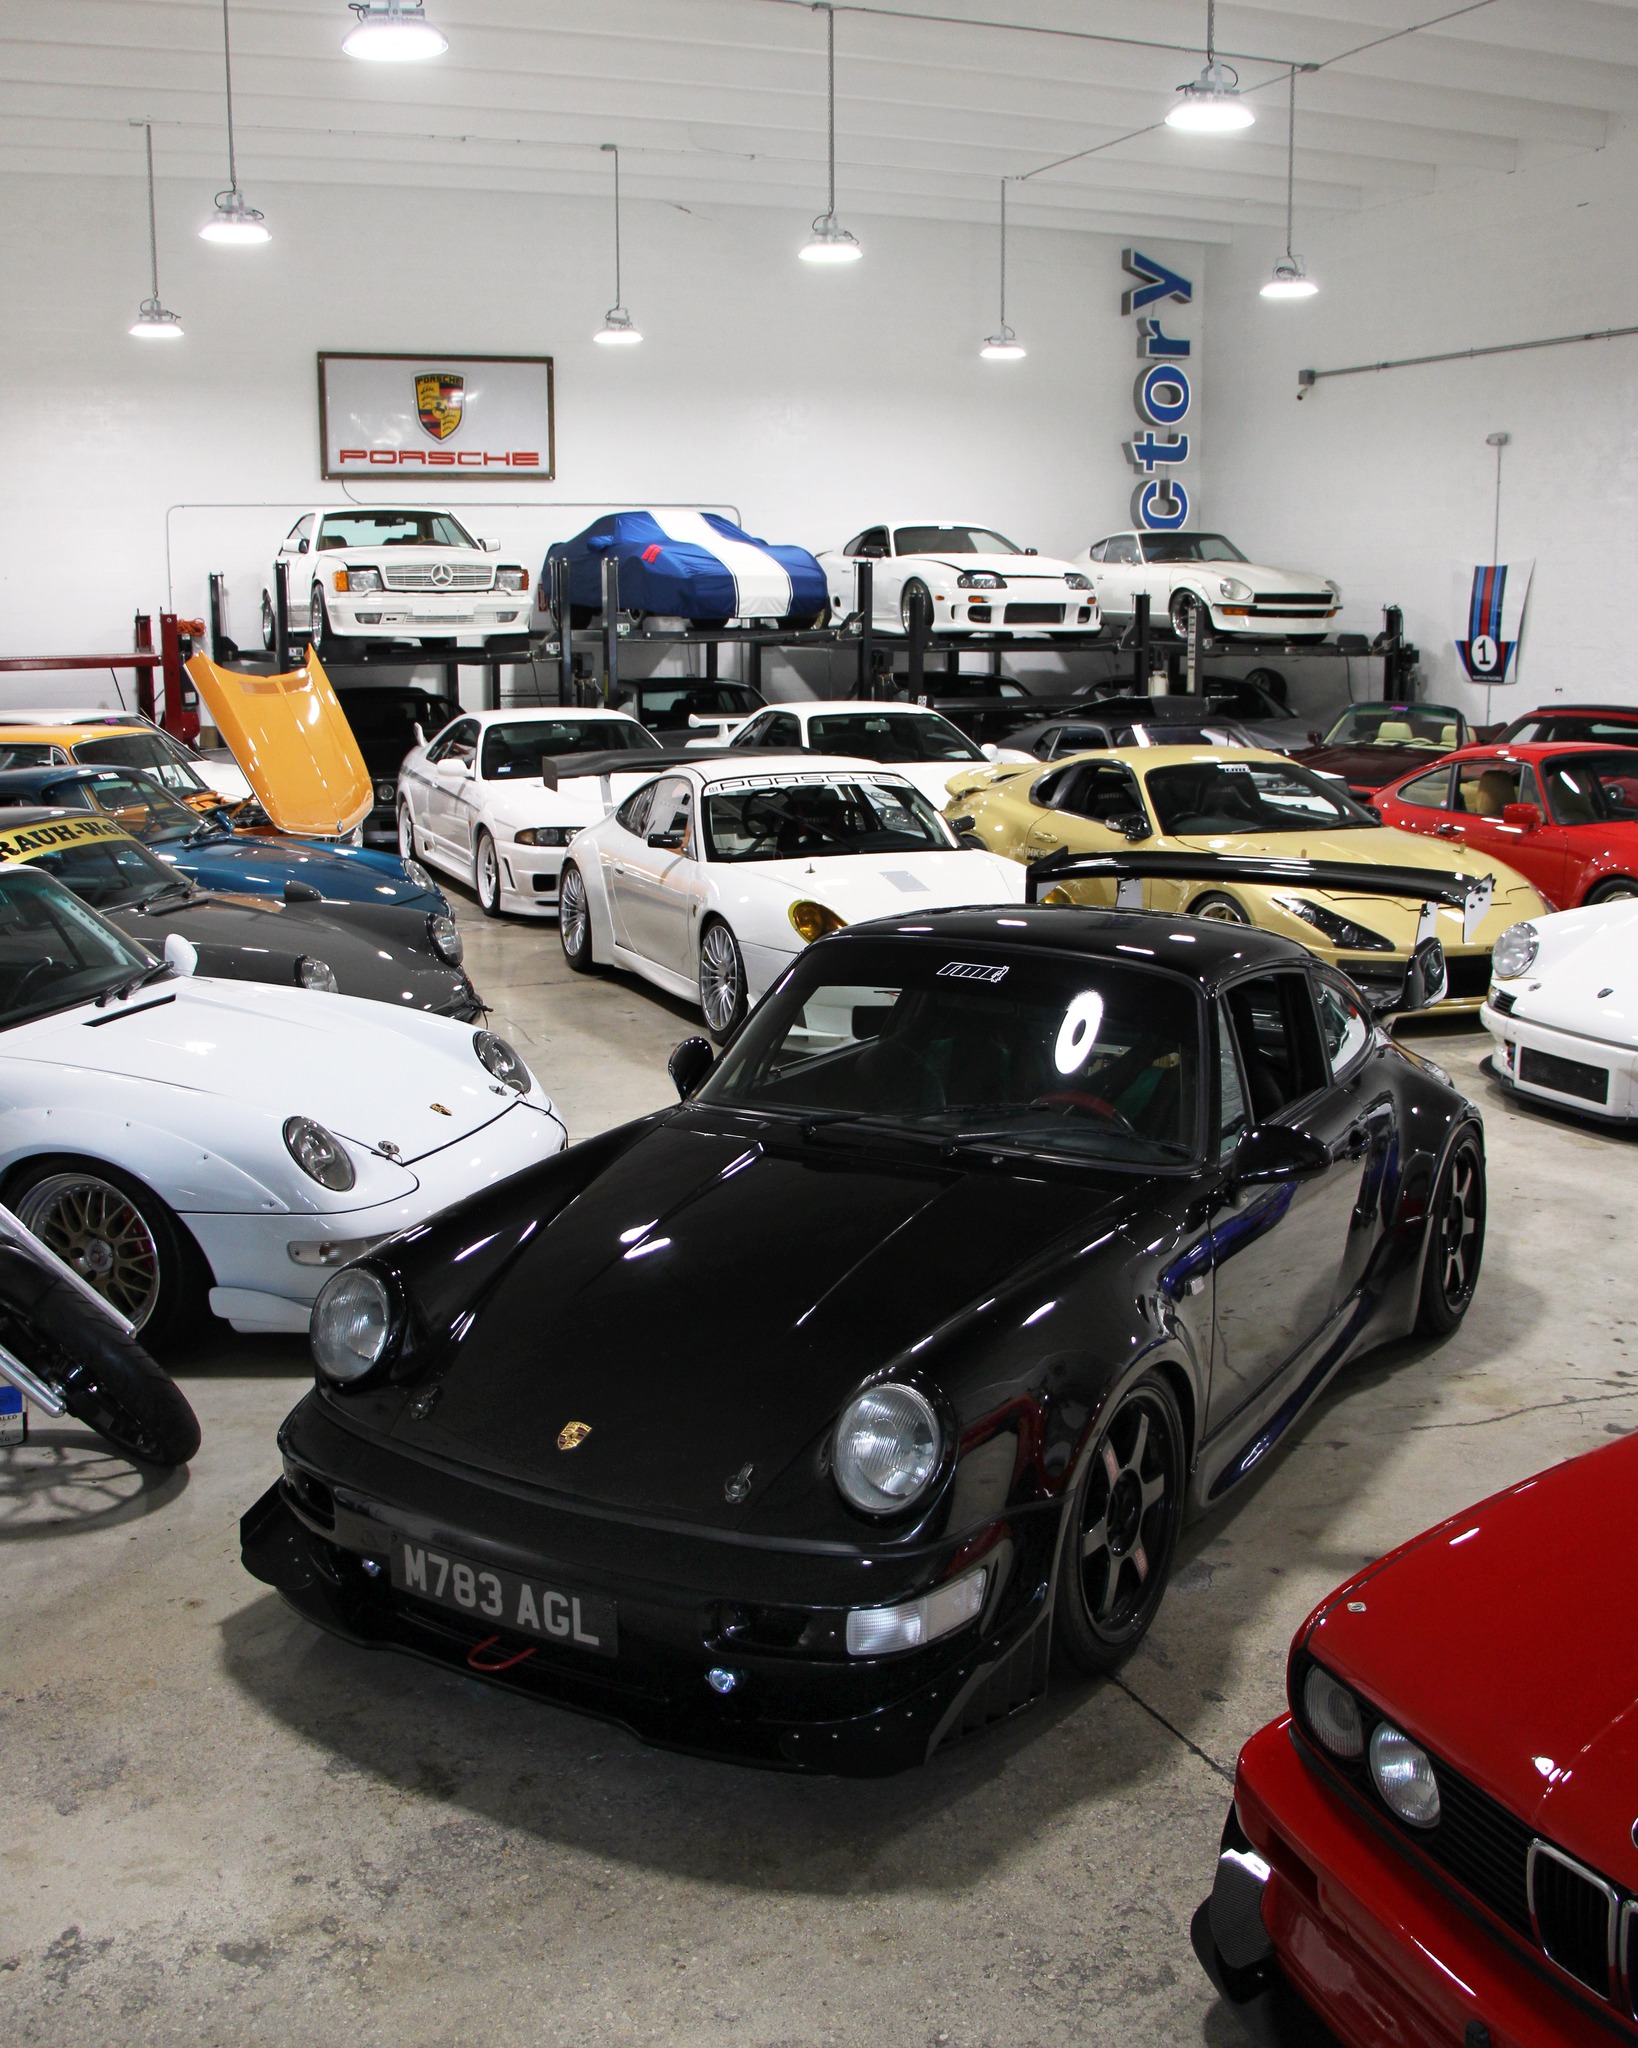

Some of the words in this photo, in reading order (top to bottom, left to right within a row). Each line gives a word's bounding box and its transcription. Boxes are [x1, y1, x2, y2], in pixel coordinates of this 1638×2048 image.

[416, 375, 464, 385] PORSCHE
[1121, 248, 1193, 530] ctory
[339, 449, 540, 466] PORSCHE
[1478, 639, 1490, 664] 1
[719, 774, 897, 791] PORSCHE
[403, 1543, 503, 1618] M783
[516, 1583, 600, 1646] AGL
